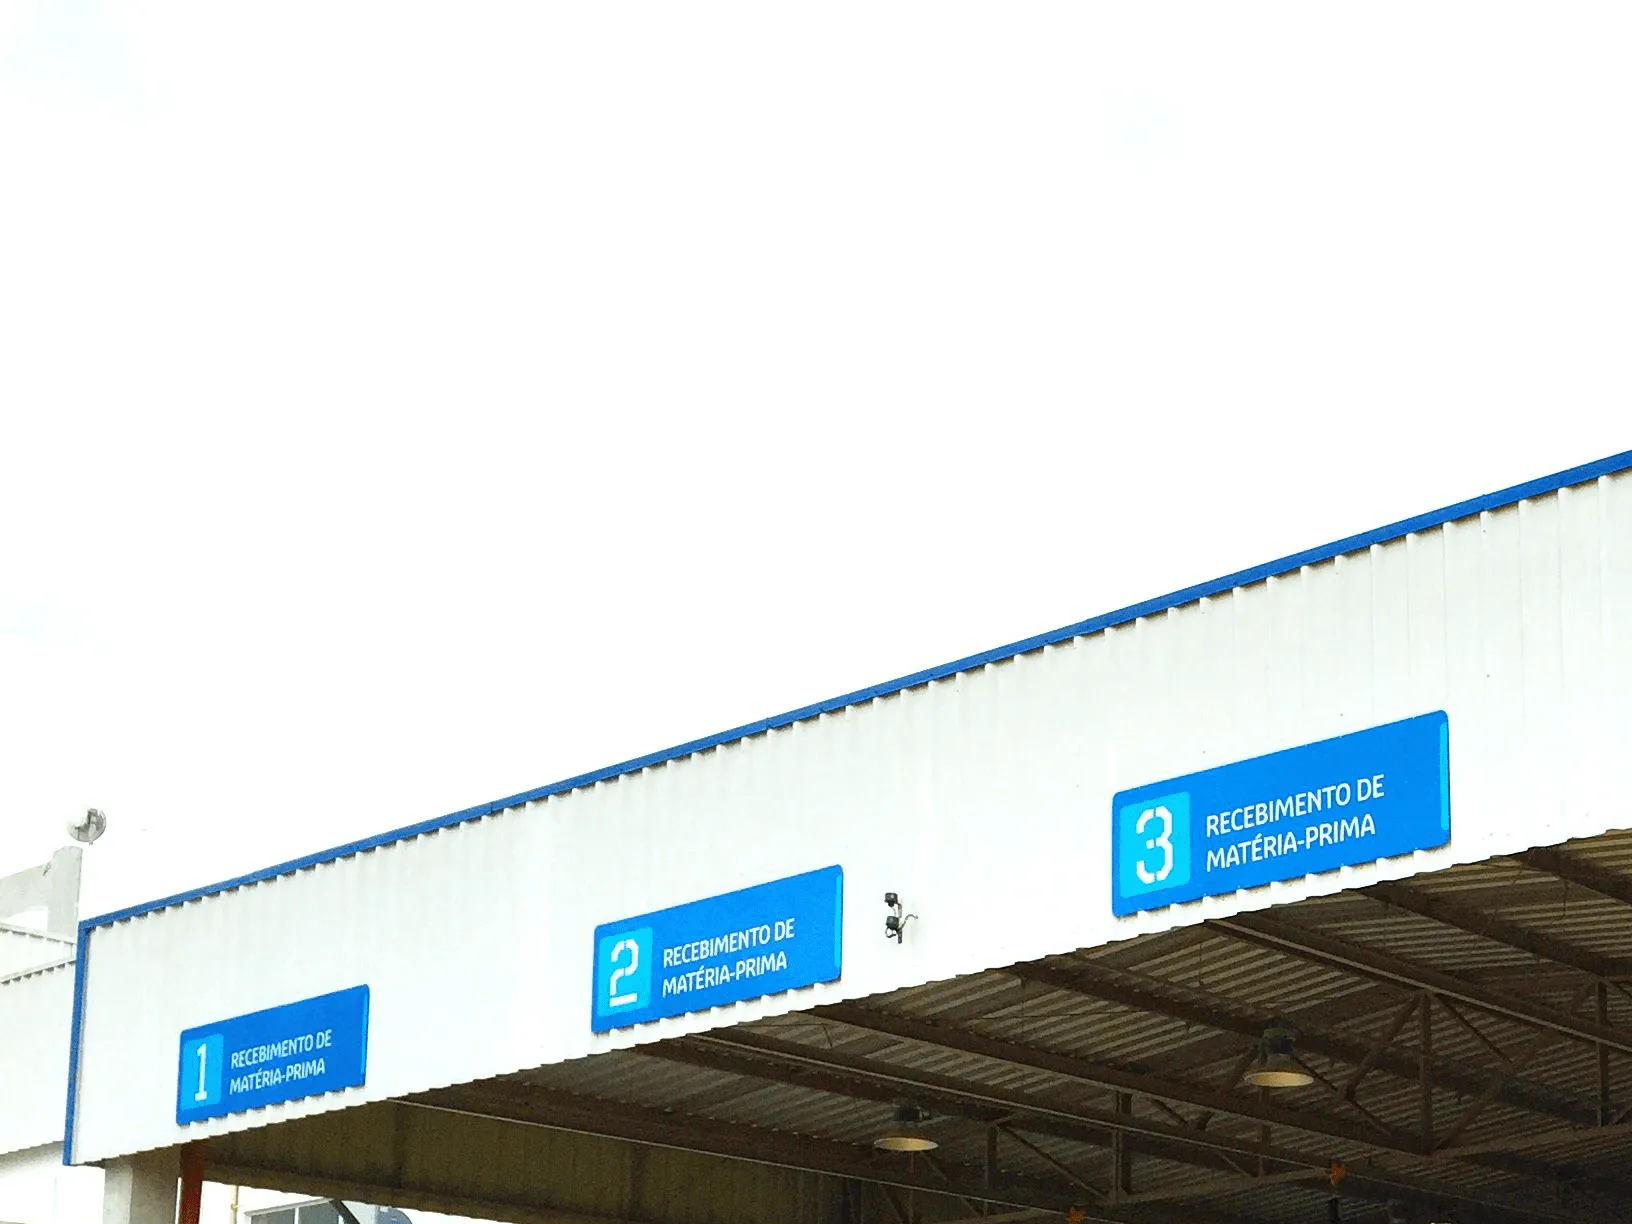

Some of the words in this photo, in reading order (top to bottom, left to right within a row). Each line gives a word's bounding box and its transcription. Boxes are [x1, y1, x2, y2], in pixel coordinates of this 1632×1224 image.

[1206, 781, 1351, 838] RECEBIMENTO
[1357, 773, 1385, 801] DE
[1136, 805, 1173, 884] 3
[1206, 813, 1376, 873] MATÉRIA-PRIMA
[663, 924, 771, 968] RECEBIMENTO
[774, 917, 795, 942] DE
[609, 938, 639, 1007] 2
[662, 950, 788, 998] MATÉRIA-PRIMA
[194, 1043, 208, 1101] 1
[229, 1058, 326, 1095] MATÉRIA-PRIMA
[231, 1033, 314, 1070] RECEBIMENTO
[316, 1028, 333, 1049] DE
